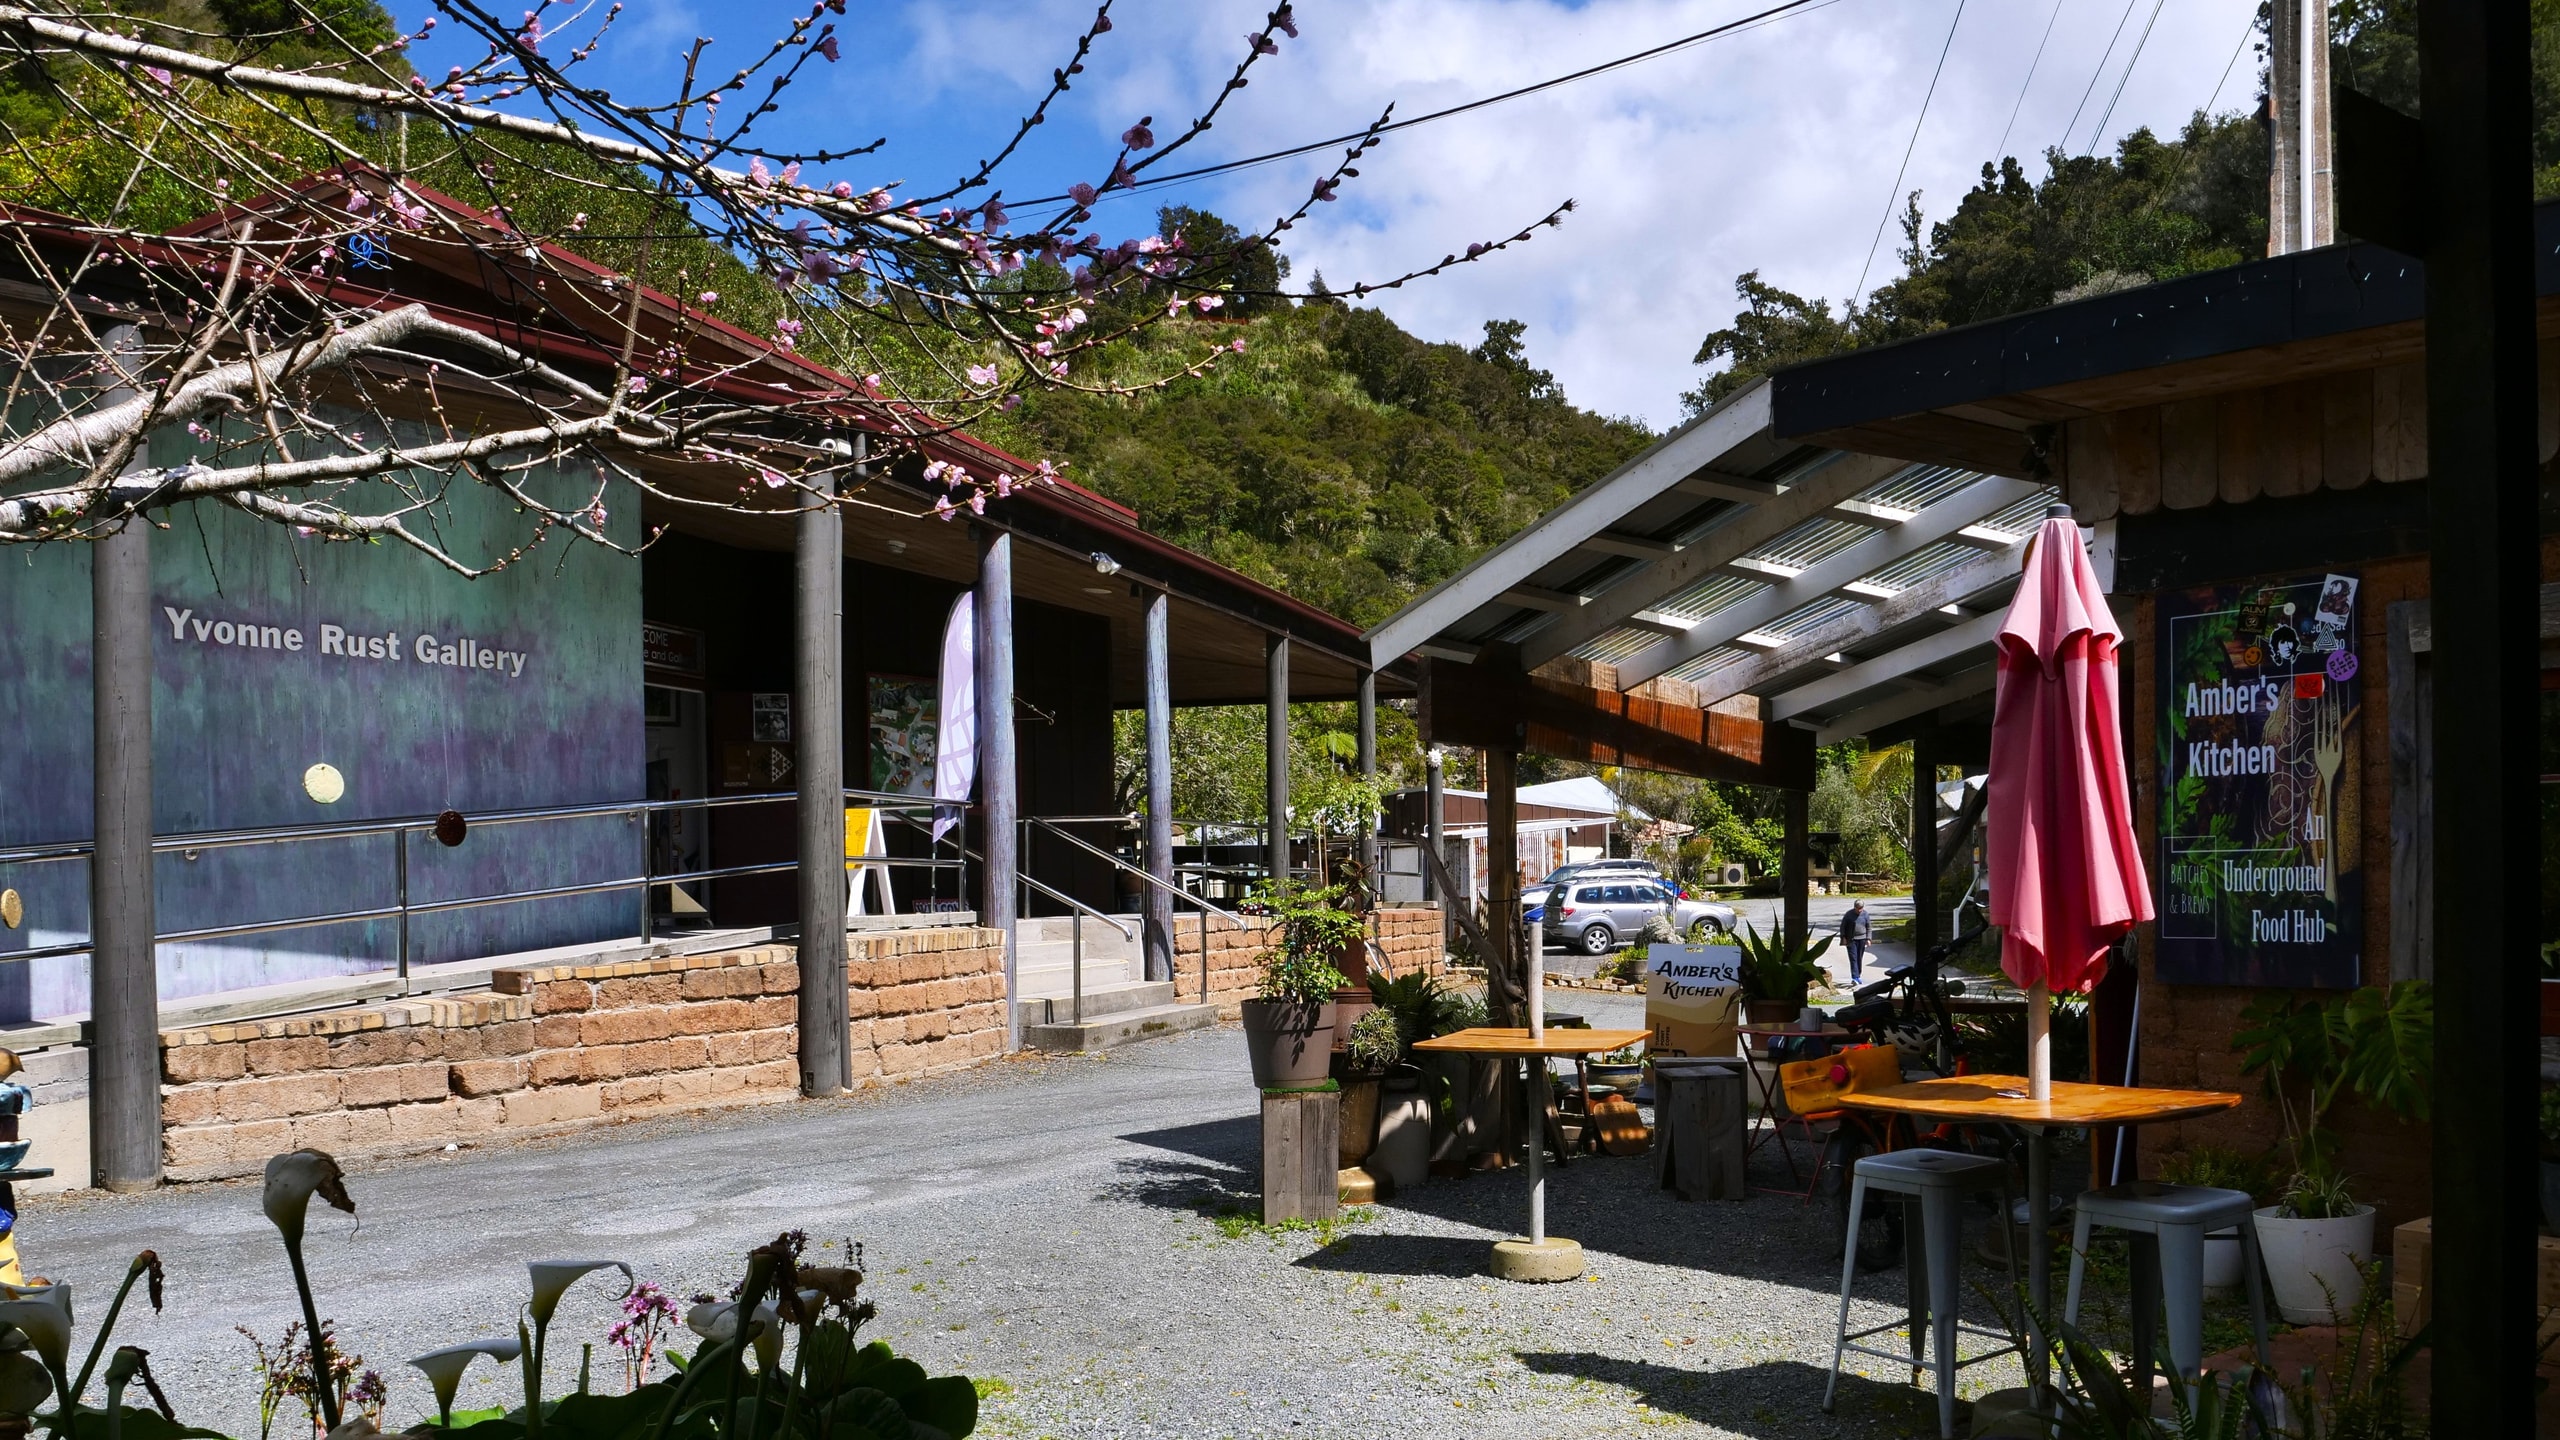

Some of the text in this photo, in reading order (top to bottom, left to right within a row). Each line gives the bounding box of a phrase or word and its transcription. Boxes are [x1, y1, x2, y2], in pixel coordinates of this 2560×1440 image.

[163, 606, 527, 678] Yvonne Rust Gallery
[643, 629, 669, 647] COME
[651, 651, 666, 661] and
[2185, 675, 2279, 718] Amber's
[2188, 738, 2276, 777] Kitchen
[2304, 807, 2325, 841] An
[2170, 863, 2209, 884] BATCHES
[2223, 858, 2325, 897] Underground
[2169, 894, 2210, 914] & BREWS
[2251, 909, 2325, 943] Food Hub
[1655, 960, 1736, 981] AMBER'S
[1663, 981, 1725, 999] KITCHEN
